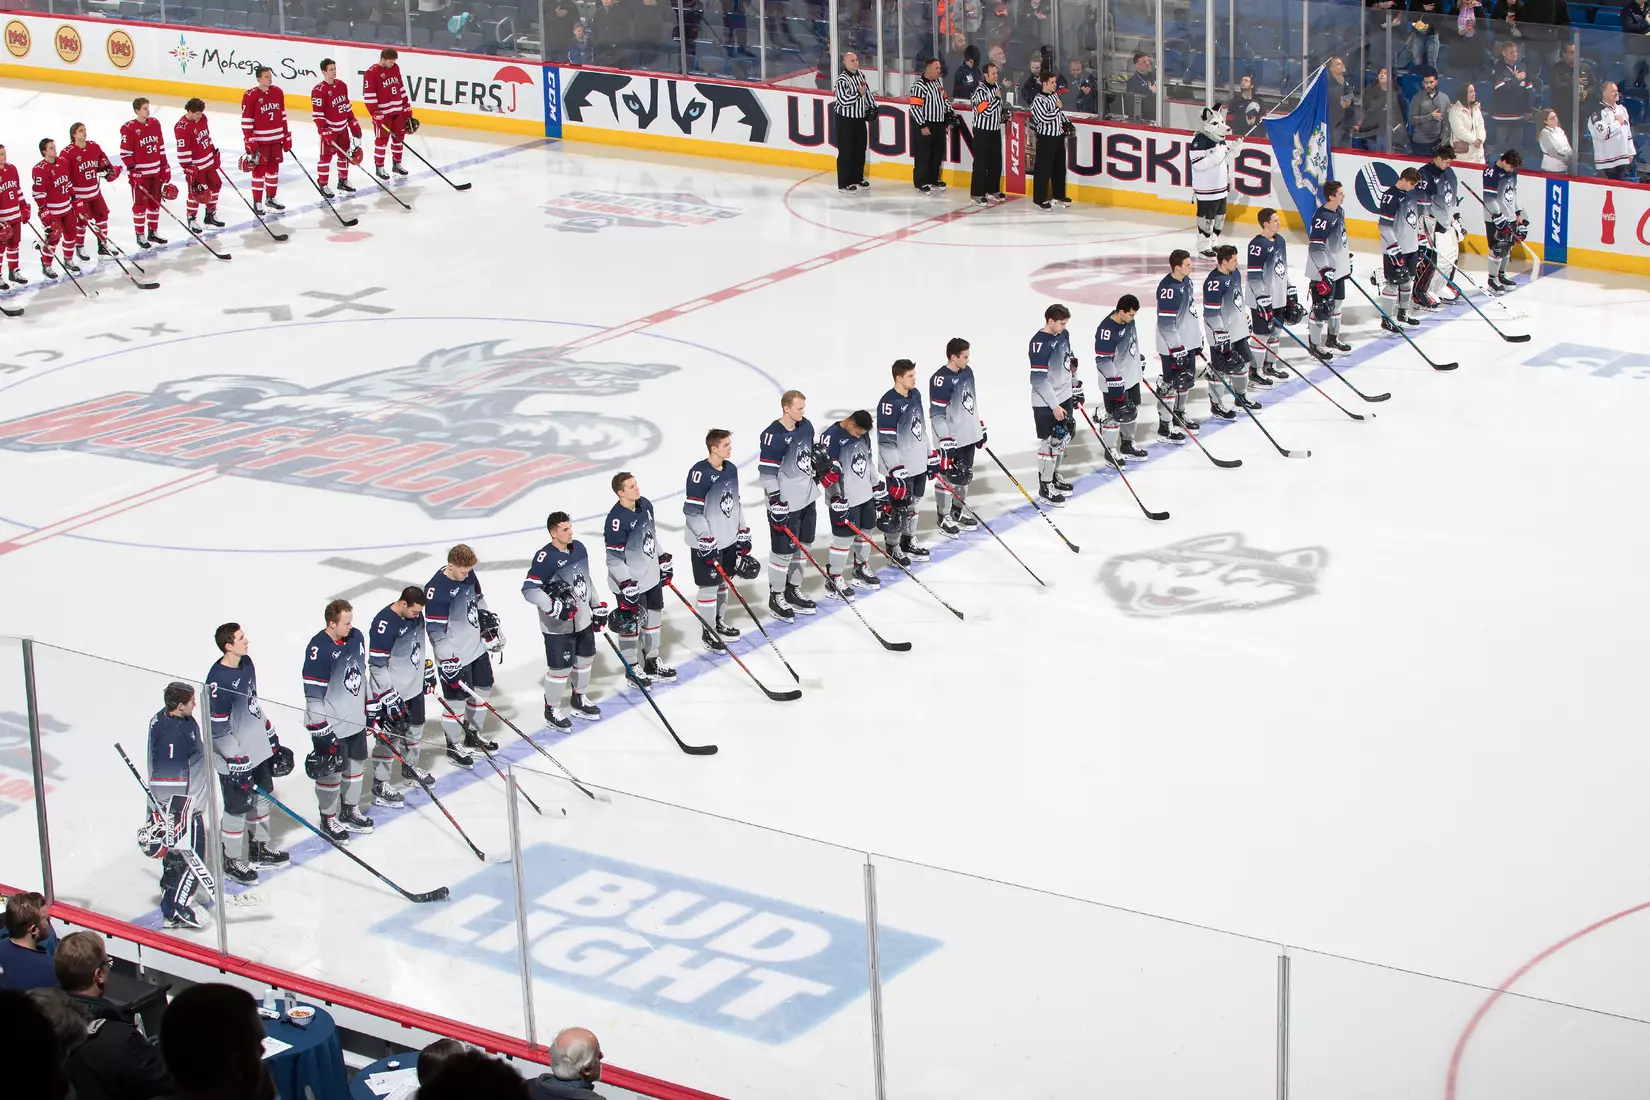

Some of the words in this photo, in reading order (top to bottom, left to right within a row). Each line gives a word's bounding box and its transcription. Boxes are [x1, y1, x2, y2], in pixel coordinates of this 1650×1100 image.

[281, 58, 318, 80] Sun
[311, 97, 323, 107] 28
[547, 70, 557, 122] CCM
[268, 112, 275, 121] 7
[146, 144, 157, 154] 34
[1010, 121, 1021, 177] CCM
[84, 170, 96, 180] 67
[8, 190, 15, 200] 6
[1382, 194, 1394, 205] 27
[1551, 183, 1563, 245] CCM
[1314, 218, 1327, 231] 24
[1249, 244, 1261, 256] 23
[1207, 280, 1220, 291] 22
[1160, 288, 1174, 300] 20
[1100, 328, 1111, 341] 19
[1032, 341, 1043, 354] 17
[933, 374, 945, 387] 16
[881, 402, 893, 416] 15
[763, 432, 773, 446] 11
[820, 432, 831, 448] 14
[0, 393, 604, 510] WOLFPACK
[691, 470, 703, 484] 10
[612, 518, 620, 532] 9
[536, 550, 548, 563] 8
[426, 586, 436, 601] 6
[377, 619, 389, 635] 5
[309, 645, 319, 661] 3
[209, 681, 218, 699] 2
[168, 743, 175, 760] 1
[177, 870, 196, 908] AUGHN
[533, 868, 833, 963] BUD
[411, 893, 836, 1024] LIGHT
